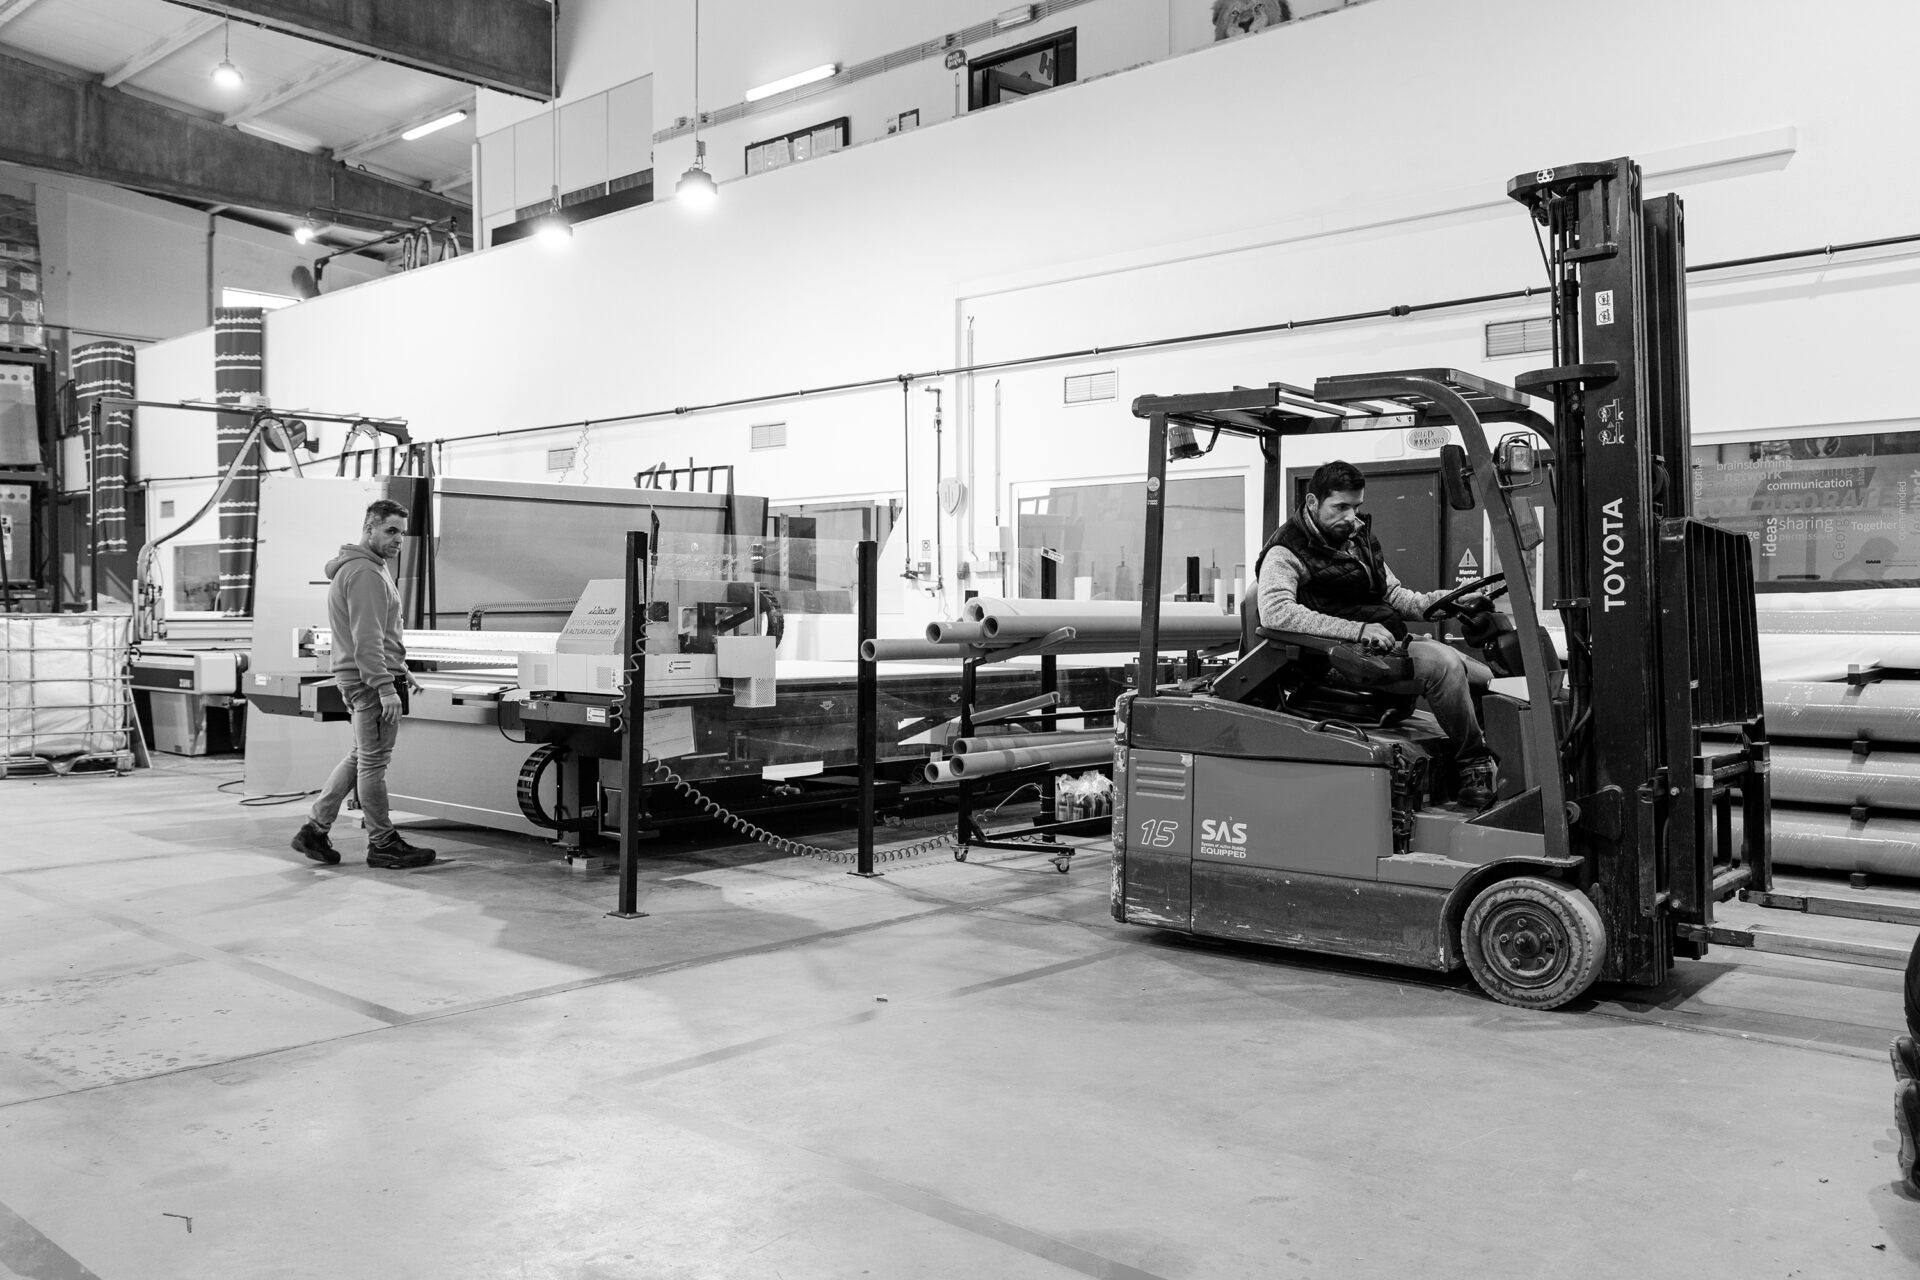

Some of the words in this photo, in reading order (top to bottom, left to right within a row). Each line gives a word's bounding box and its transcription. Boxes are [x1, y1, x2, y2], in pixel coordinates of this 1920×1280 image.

[1716, 459, 1793, 471] brainstorming
[1724, 471, 1782, 481] network
[1767, 477, 1853, 491] communication
[1779, 516, 1834, 532] sharing
[1851, 520, 1899, 532] Together
[1762, 518, 1777, 557] ideas
[1602, 497, 1626, 612] TOYOTA
[1141, 819, 1179, 847] 15
[1201, 819, 1247, 845] SAS
[1200, 846, 1247, 859] EQUIPPED
